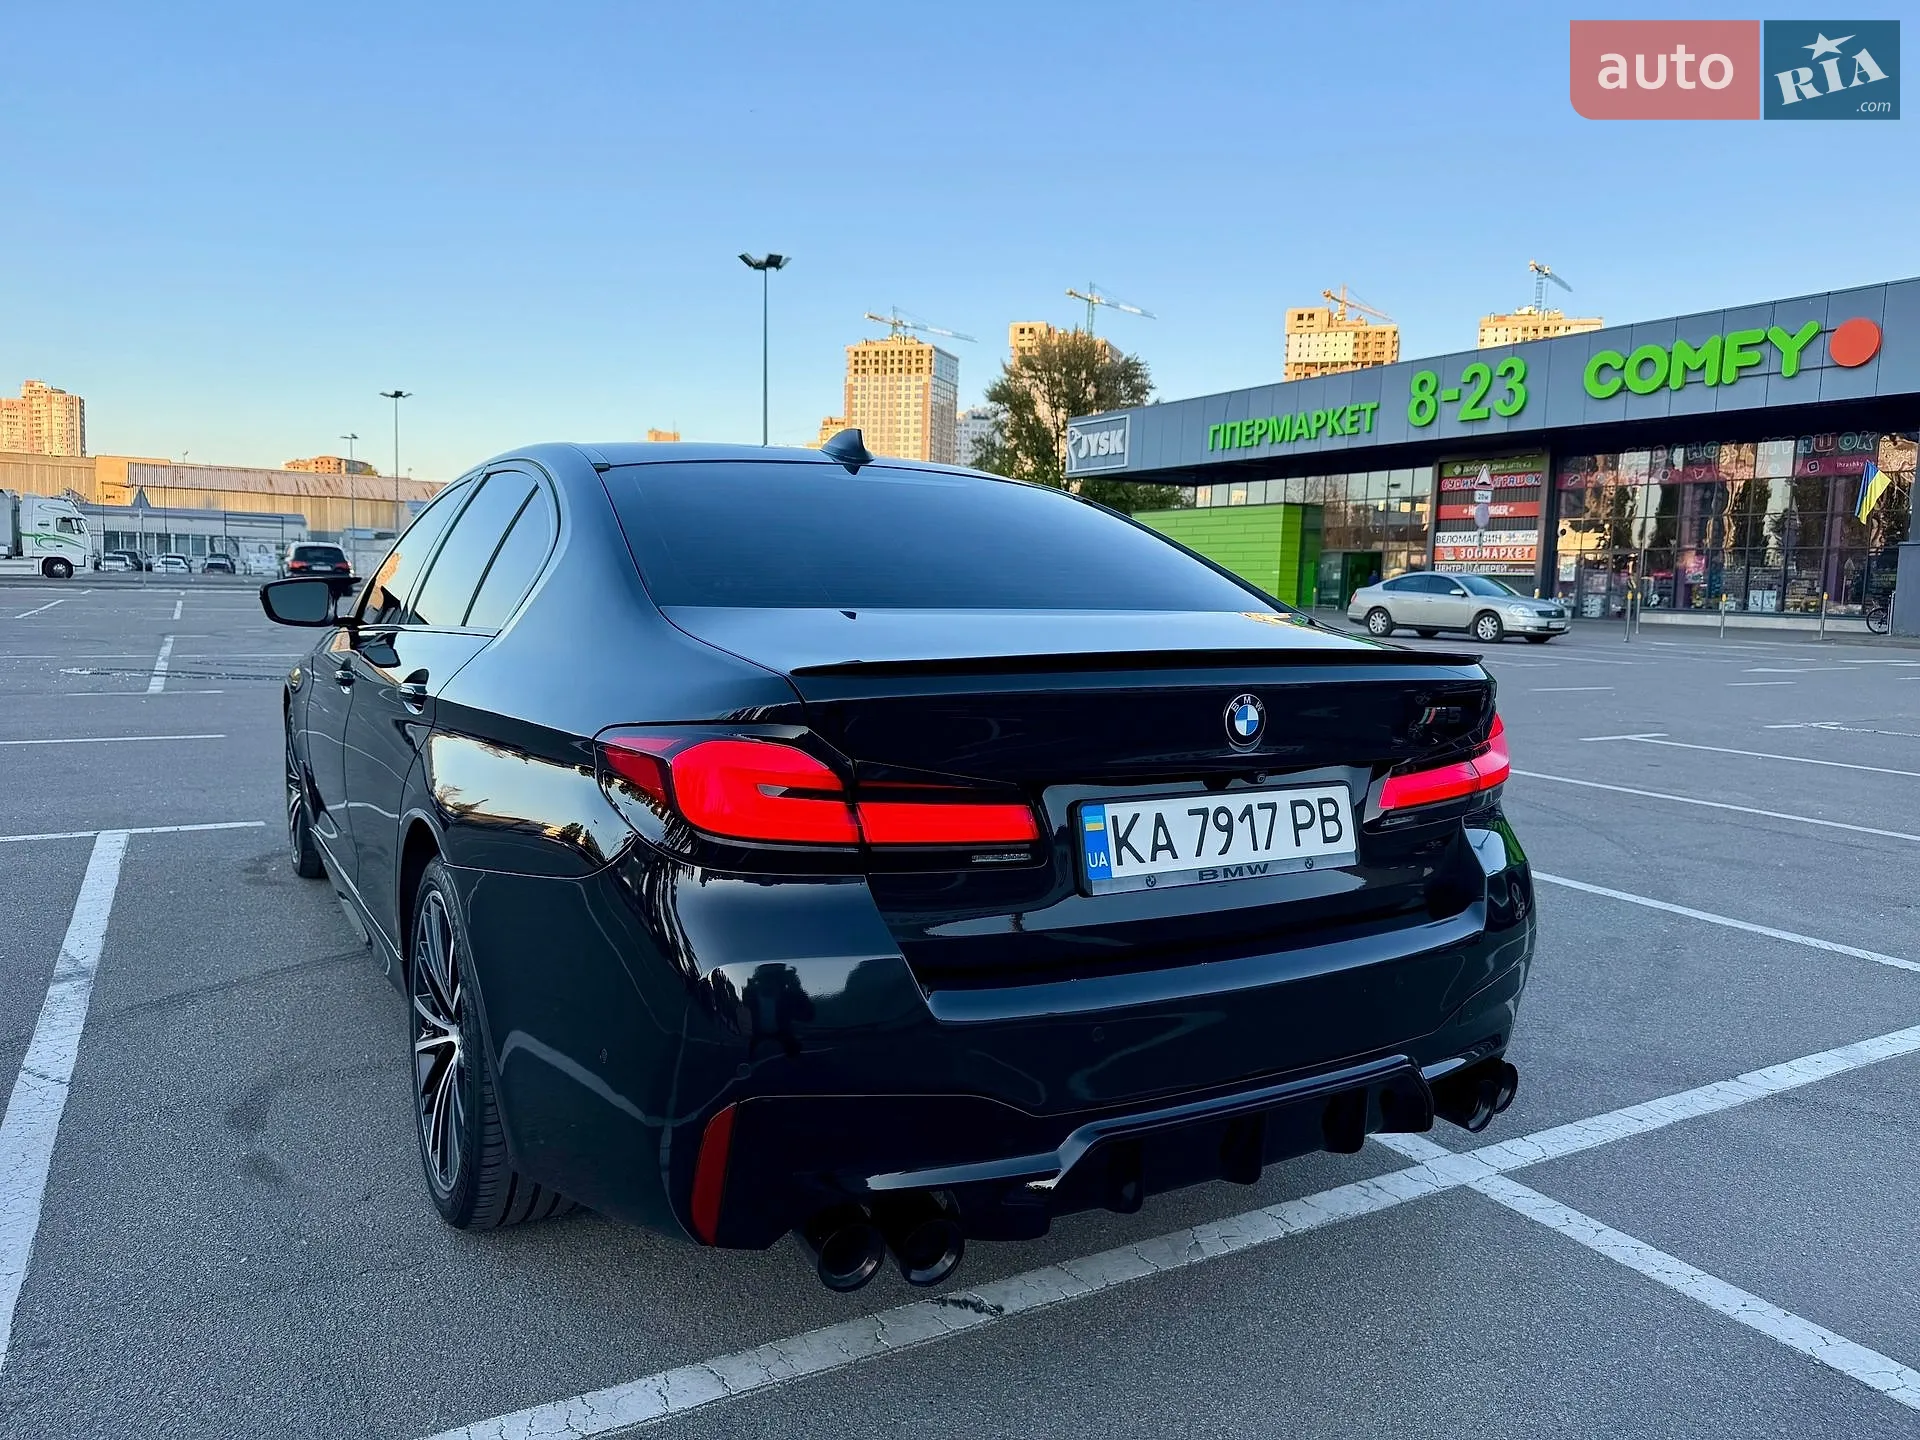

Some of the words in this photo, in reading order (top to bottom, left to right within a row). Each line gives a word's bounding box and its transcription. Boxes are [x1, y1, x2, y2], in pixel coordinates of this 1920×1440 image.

[1583, 318, 1822, 399] COMFY
[1407, 356, 1528, 427] 8-23
[1208, 401, 1380, 451] ГІПЕРМАРКЕТ
[1078, 428, 1125, 459] JYSK
[1436, 532, 1502, 544] ВЕЛОМАГЗИН
[1230, 695, 1263, 713] BMW
[1111, 812, 1179, 867] KA
[1187, 801, 1278, 858] 7917
[1289, 796, 1343, 848] PB
[1087, 851, 1109, 868] UA
[1198, 863, 1269, 882] BMW
